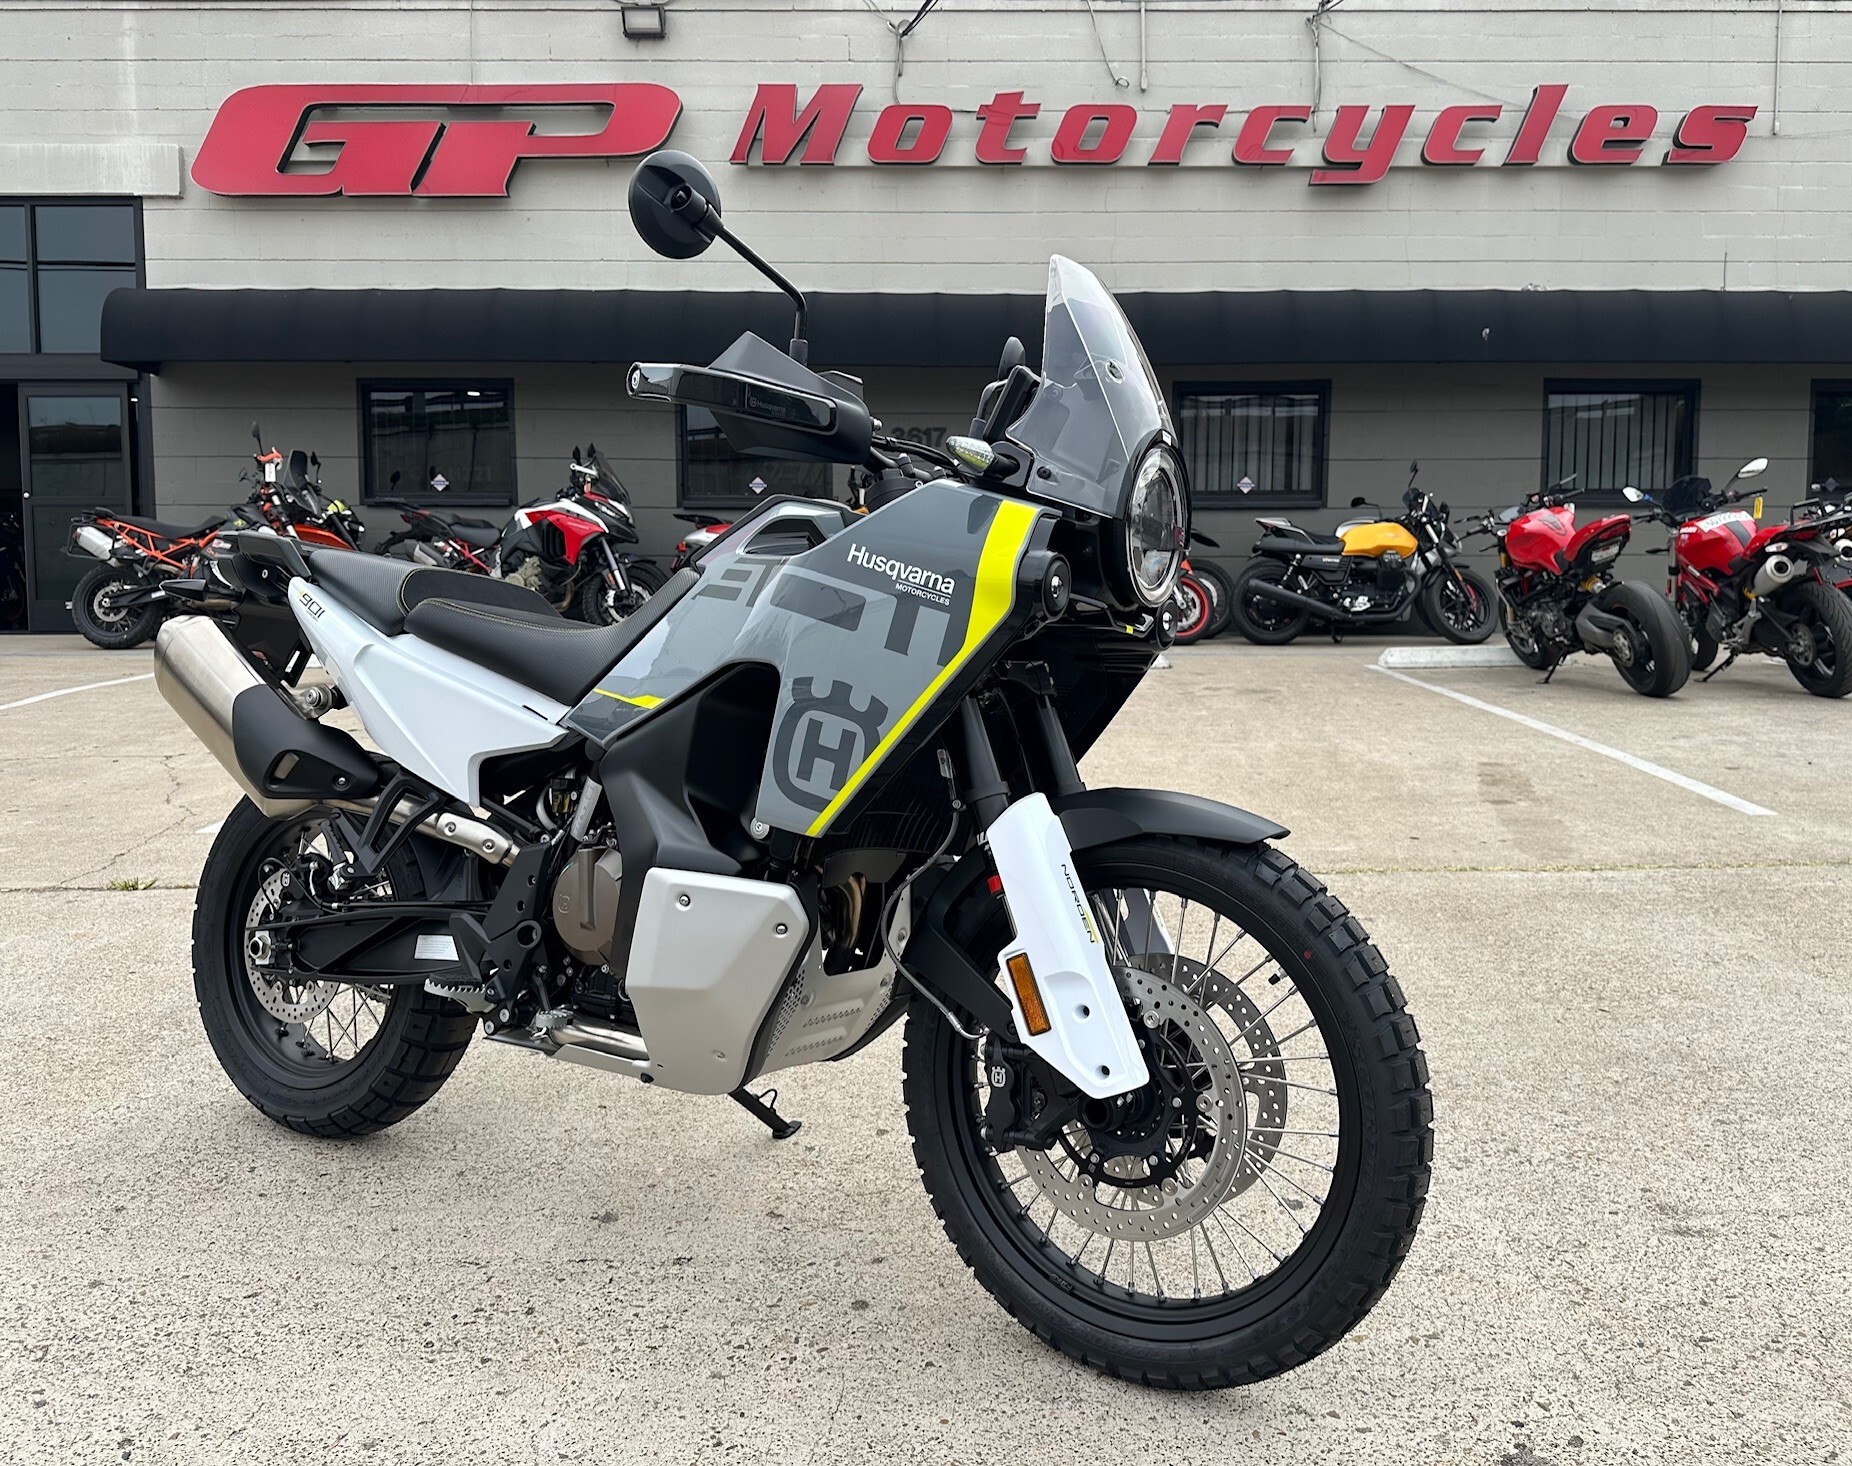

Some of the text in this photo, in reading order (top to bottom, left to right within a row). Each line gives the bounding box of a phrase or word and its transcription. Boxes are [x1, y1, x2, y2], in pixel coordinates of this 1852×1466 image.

[190, 83, 1759, 197] GP Motorcycles
[846, 543, 955, 594] Husqvarna
[895, 582, 950, 606] MOTORCYCLES
[299, 593, 326, 618] 901
[1061, 863, 1095, 943] NORDEN
